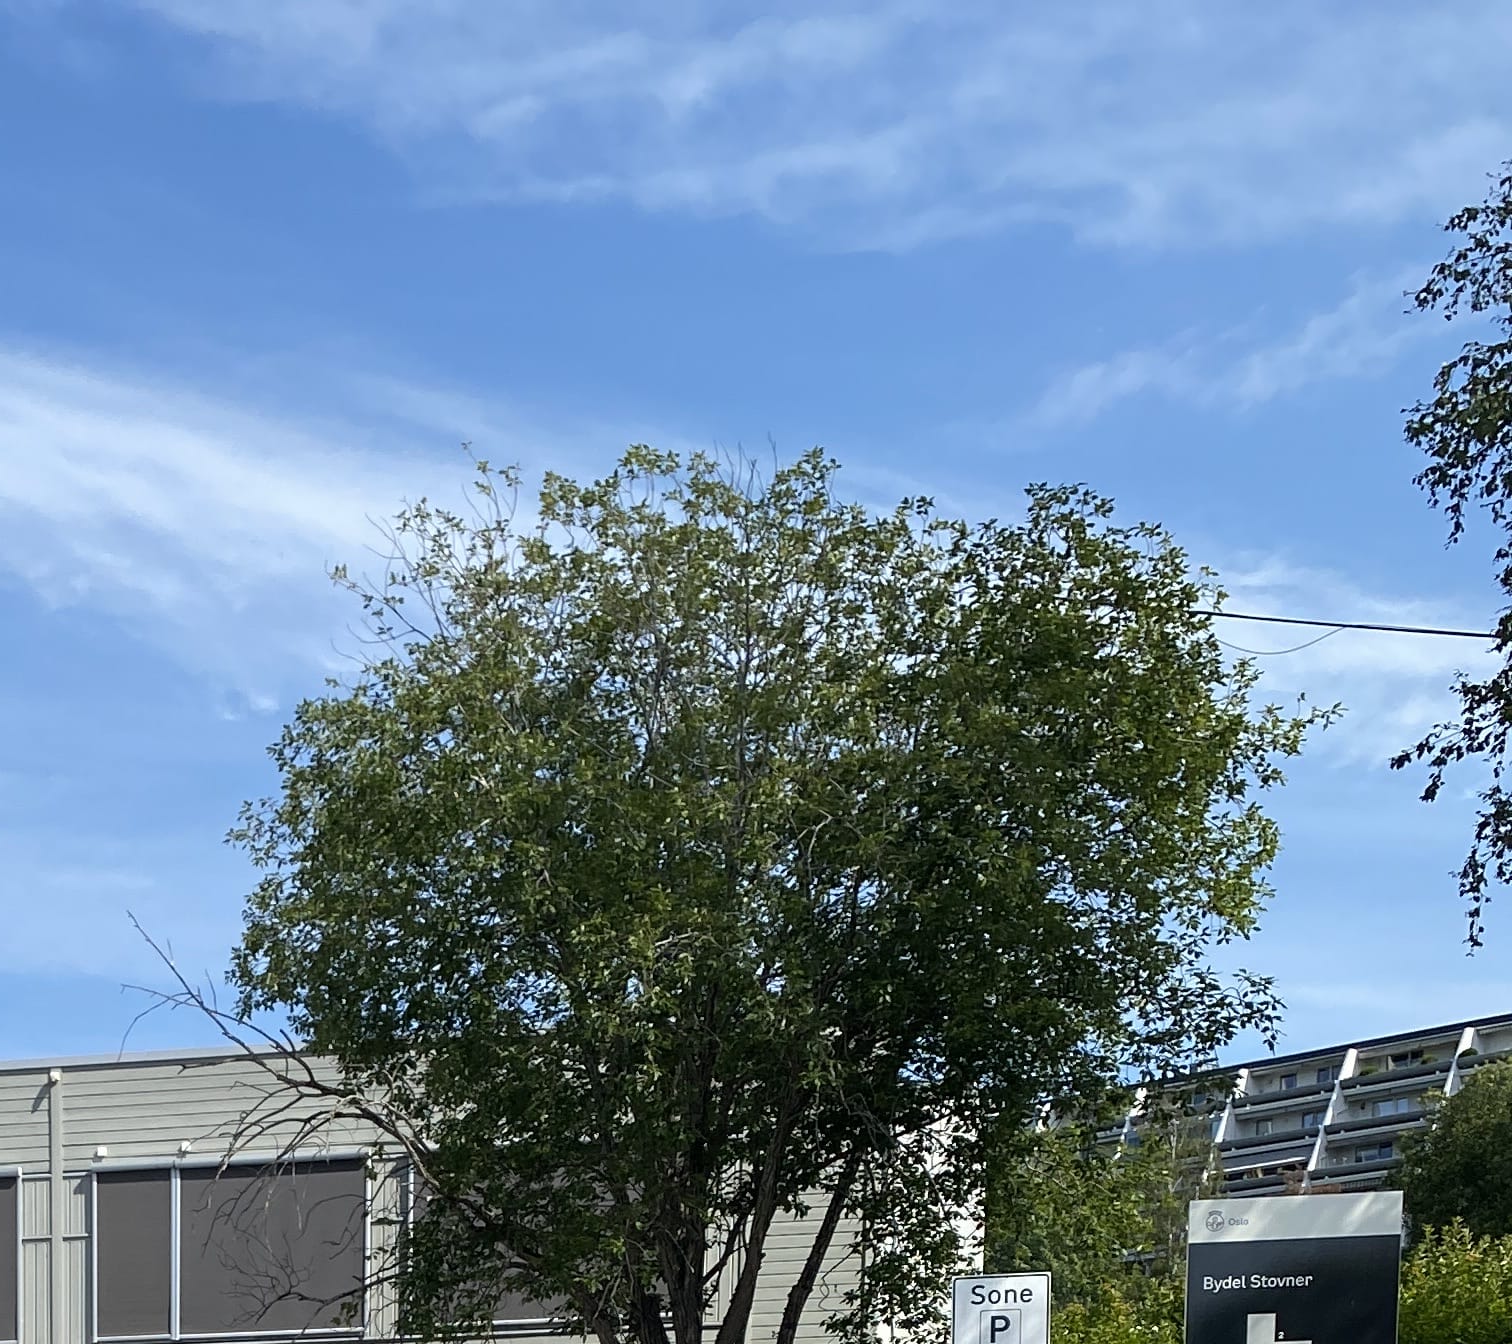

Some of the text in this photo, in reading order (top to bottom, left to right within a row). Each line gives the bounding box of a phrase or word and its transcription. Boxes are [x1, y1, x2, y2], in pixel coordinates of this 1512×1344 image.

[1228, 1217, 1249, 1226] Oslo
[1203, 1274, 1313, 1293] Bydel Stovner
[971, 1285, 1033, 1305] Sone
[990, 1315, 1011, 1343] P
[1278, 1331, 1285, 1340] 2
